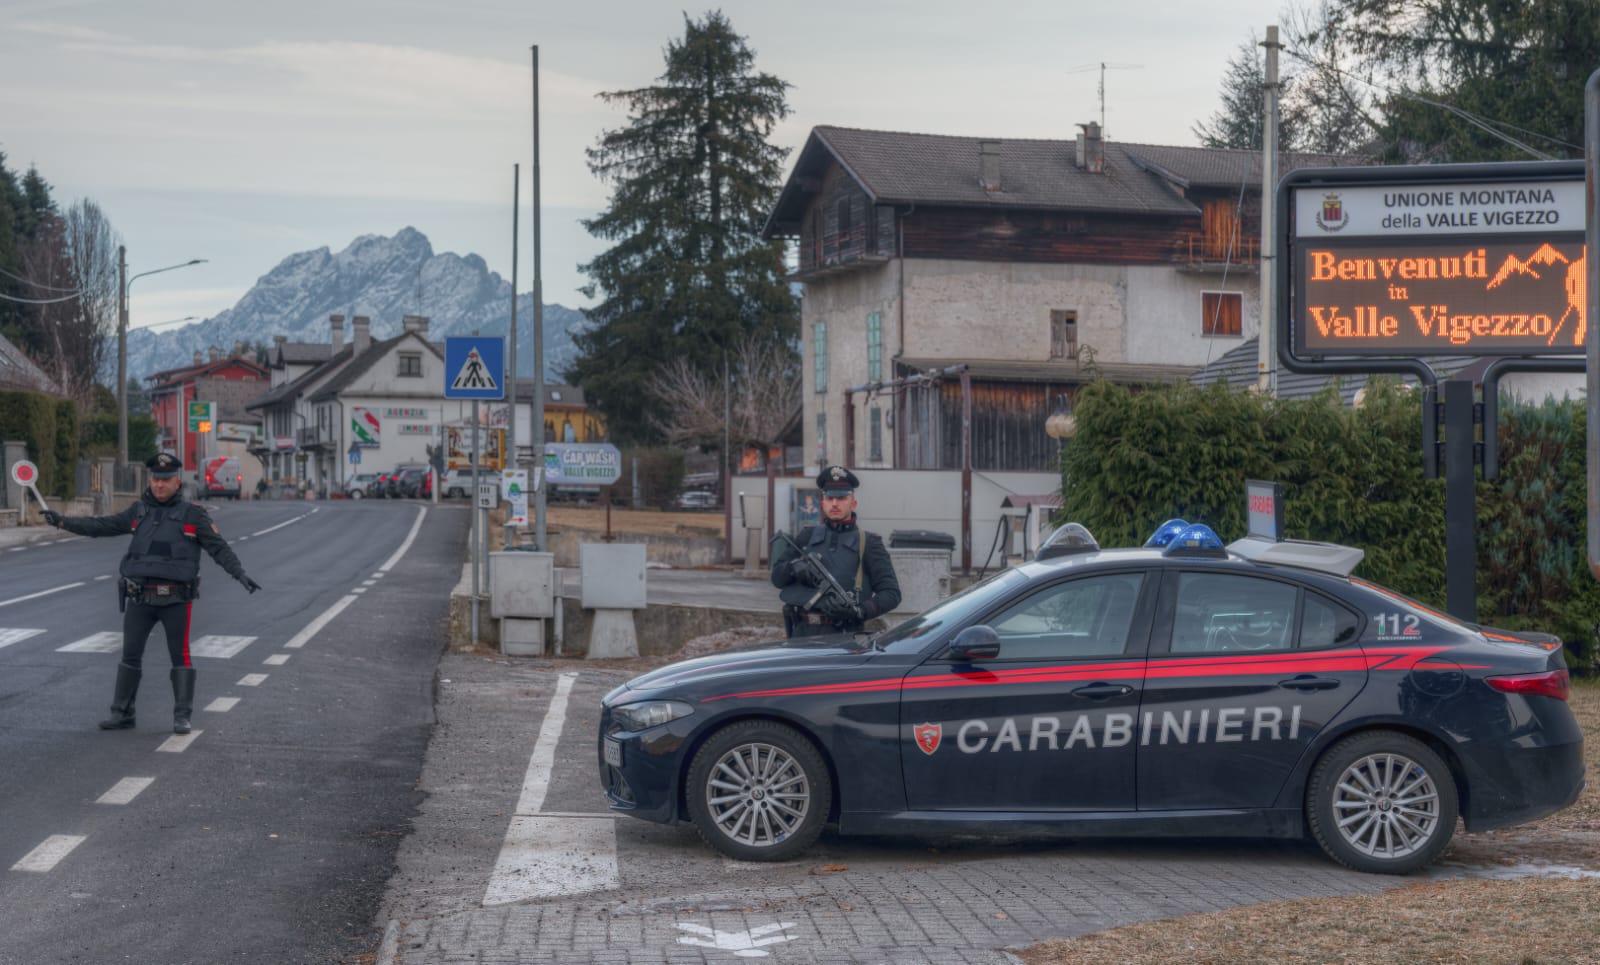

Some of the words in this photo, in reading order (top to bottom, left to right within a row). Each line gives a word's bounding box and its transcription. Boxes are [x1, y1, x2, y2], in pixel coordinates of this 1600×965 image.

[1384, 192, 1454, 207] UNIONE
[1459, 189, 1555, 205] MONTANA
[1382, 213, 1421, 228] della
[1426, 211, 1478, 227] VALLE
[1482, 209, 1560, 226] VIGEZZO
[1311, 248, 1488, 281] Benvenuti
[1388, 283, 1409, 300] in
[1309, 305, 1399, 338] Valle
[1409, 304, 1553, 345] Vigezzo
[387, 407, 425, 417] AGENZIA
[563, 451, 584, 465] CAR
[585, 450, 616, 465] WASH
[563, 466, 584, 478] VALLE
[1373, 612, 1420, 636] 112
[956, 705, 1302, 754] CARABINIERI
